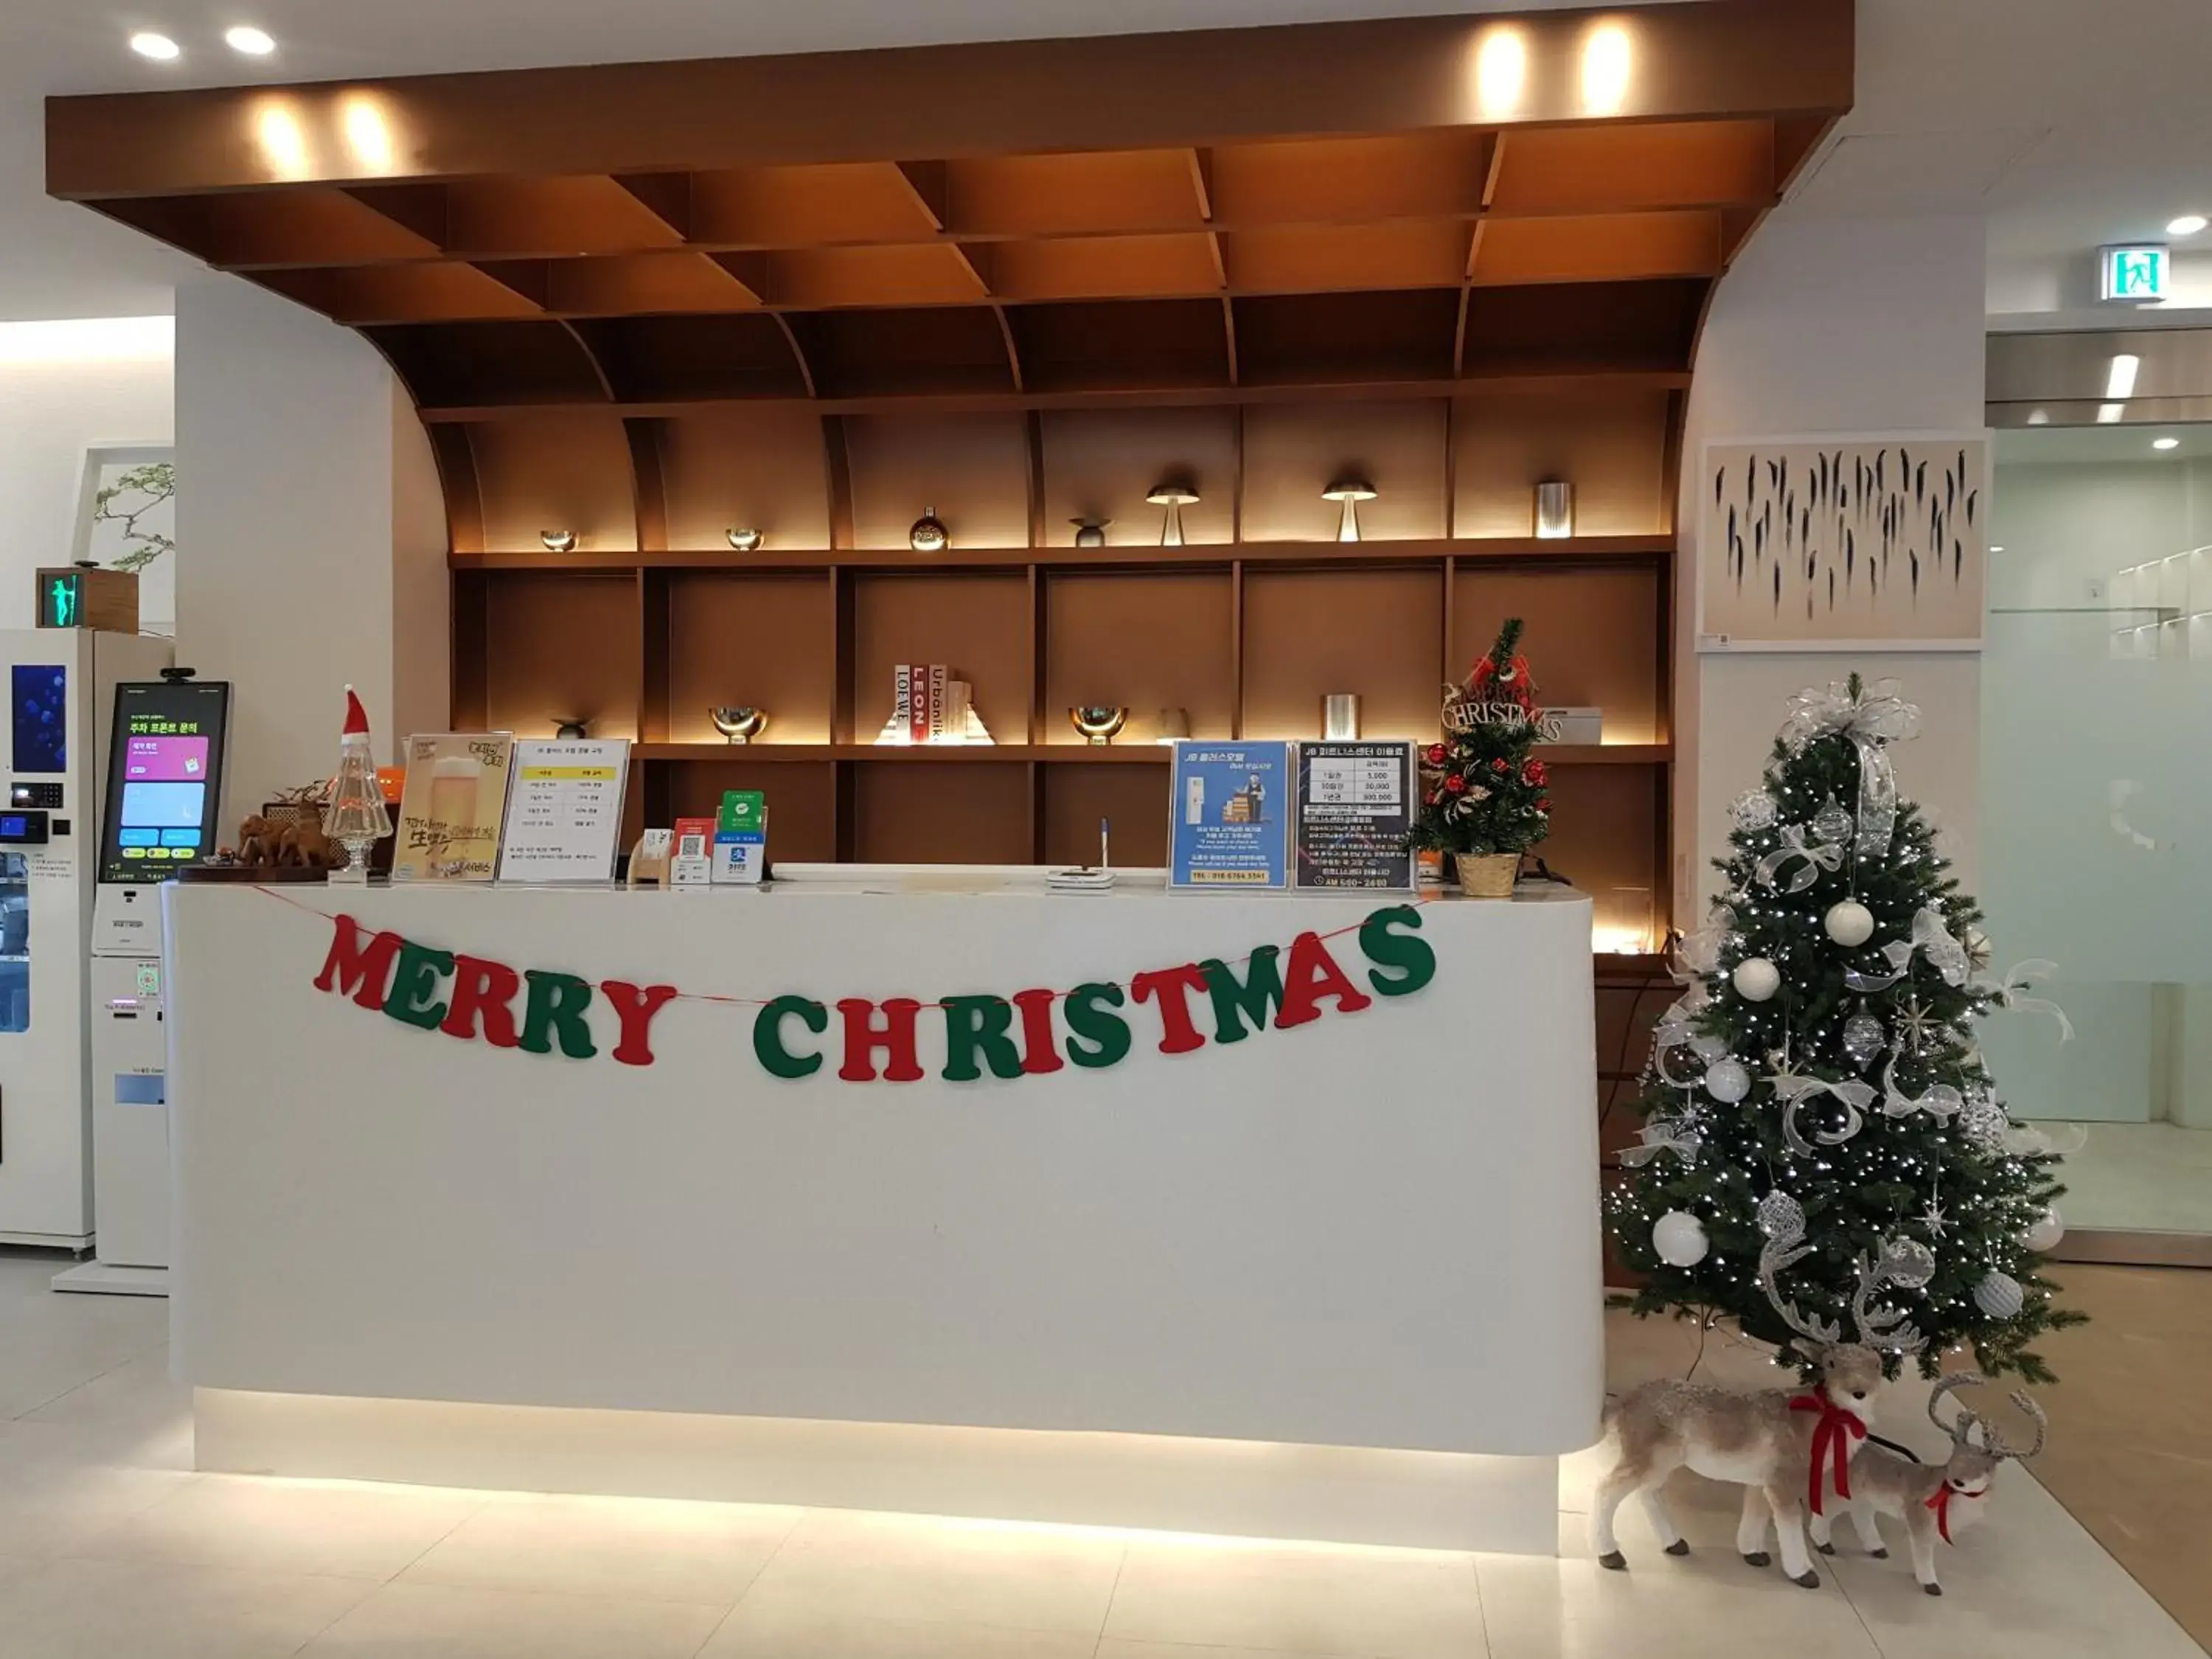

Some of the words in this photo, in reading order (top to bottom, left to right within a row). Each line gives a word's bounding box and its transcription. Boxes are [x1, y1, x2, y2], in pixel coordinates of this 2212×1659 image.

[897, 672, 909, 721] LOEWE
[914, 667, 924, 724] LEON
[1306, 747, 1317, 756] JB
[1319, 747, 1374, 756] 피트니스센터
[1376, 747, 1404, 756] 이용료
[313, 914, 677, 1065] MERRY
[754, 905, 1436, 1082] CHRISTMAS
